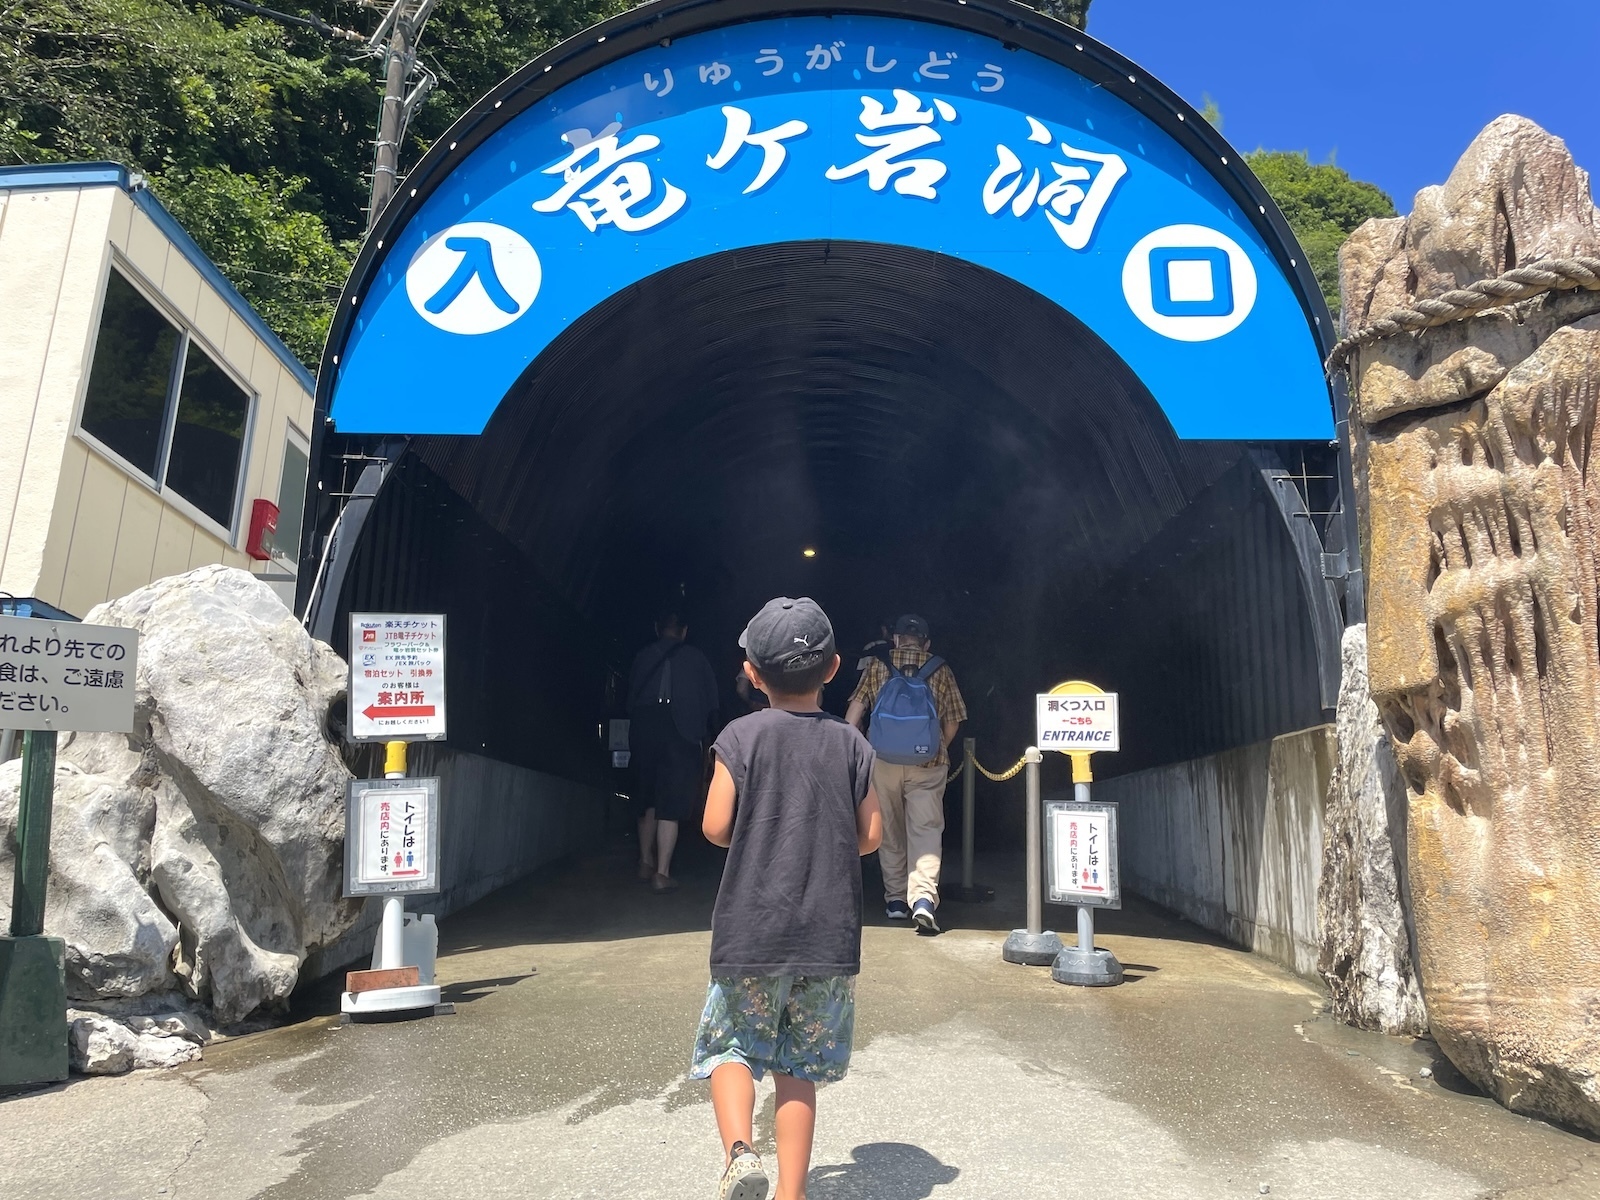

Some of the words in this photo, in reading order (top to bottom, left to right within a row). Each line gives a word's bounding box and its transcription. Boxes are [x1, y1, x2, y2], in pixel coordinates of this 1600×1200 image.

[643, 41, 1006, 97] りゅうがしどう
[424, 237, 521, 316] 入
[1149, 246, 1236, 317] 口
[385, 620, 438, 629] 楽天チケット
[385, 631, 437, 640] JTB電子チケット
[0, 634, 126, 661] れより先での
[364, 669, 403, 678] 宿泊セット
[410, 669, 433, 678] 引換券
[377, 691, 425, 705] 案内所
[1047, 700, 1106, 712] 洞くつ入口
[1042, 730, 1112, 742] ENTRANCE
[402, 801, 415, 848] トイレは
[380, 802, 390, 876] 売店内にあります。
[1088, 823, 1099, 867] トイレは
[1069, 821, 1079, 889] 売店内にあります。
